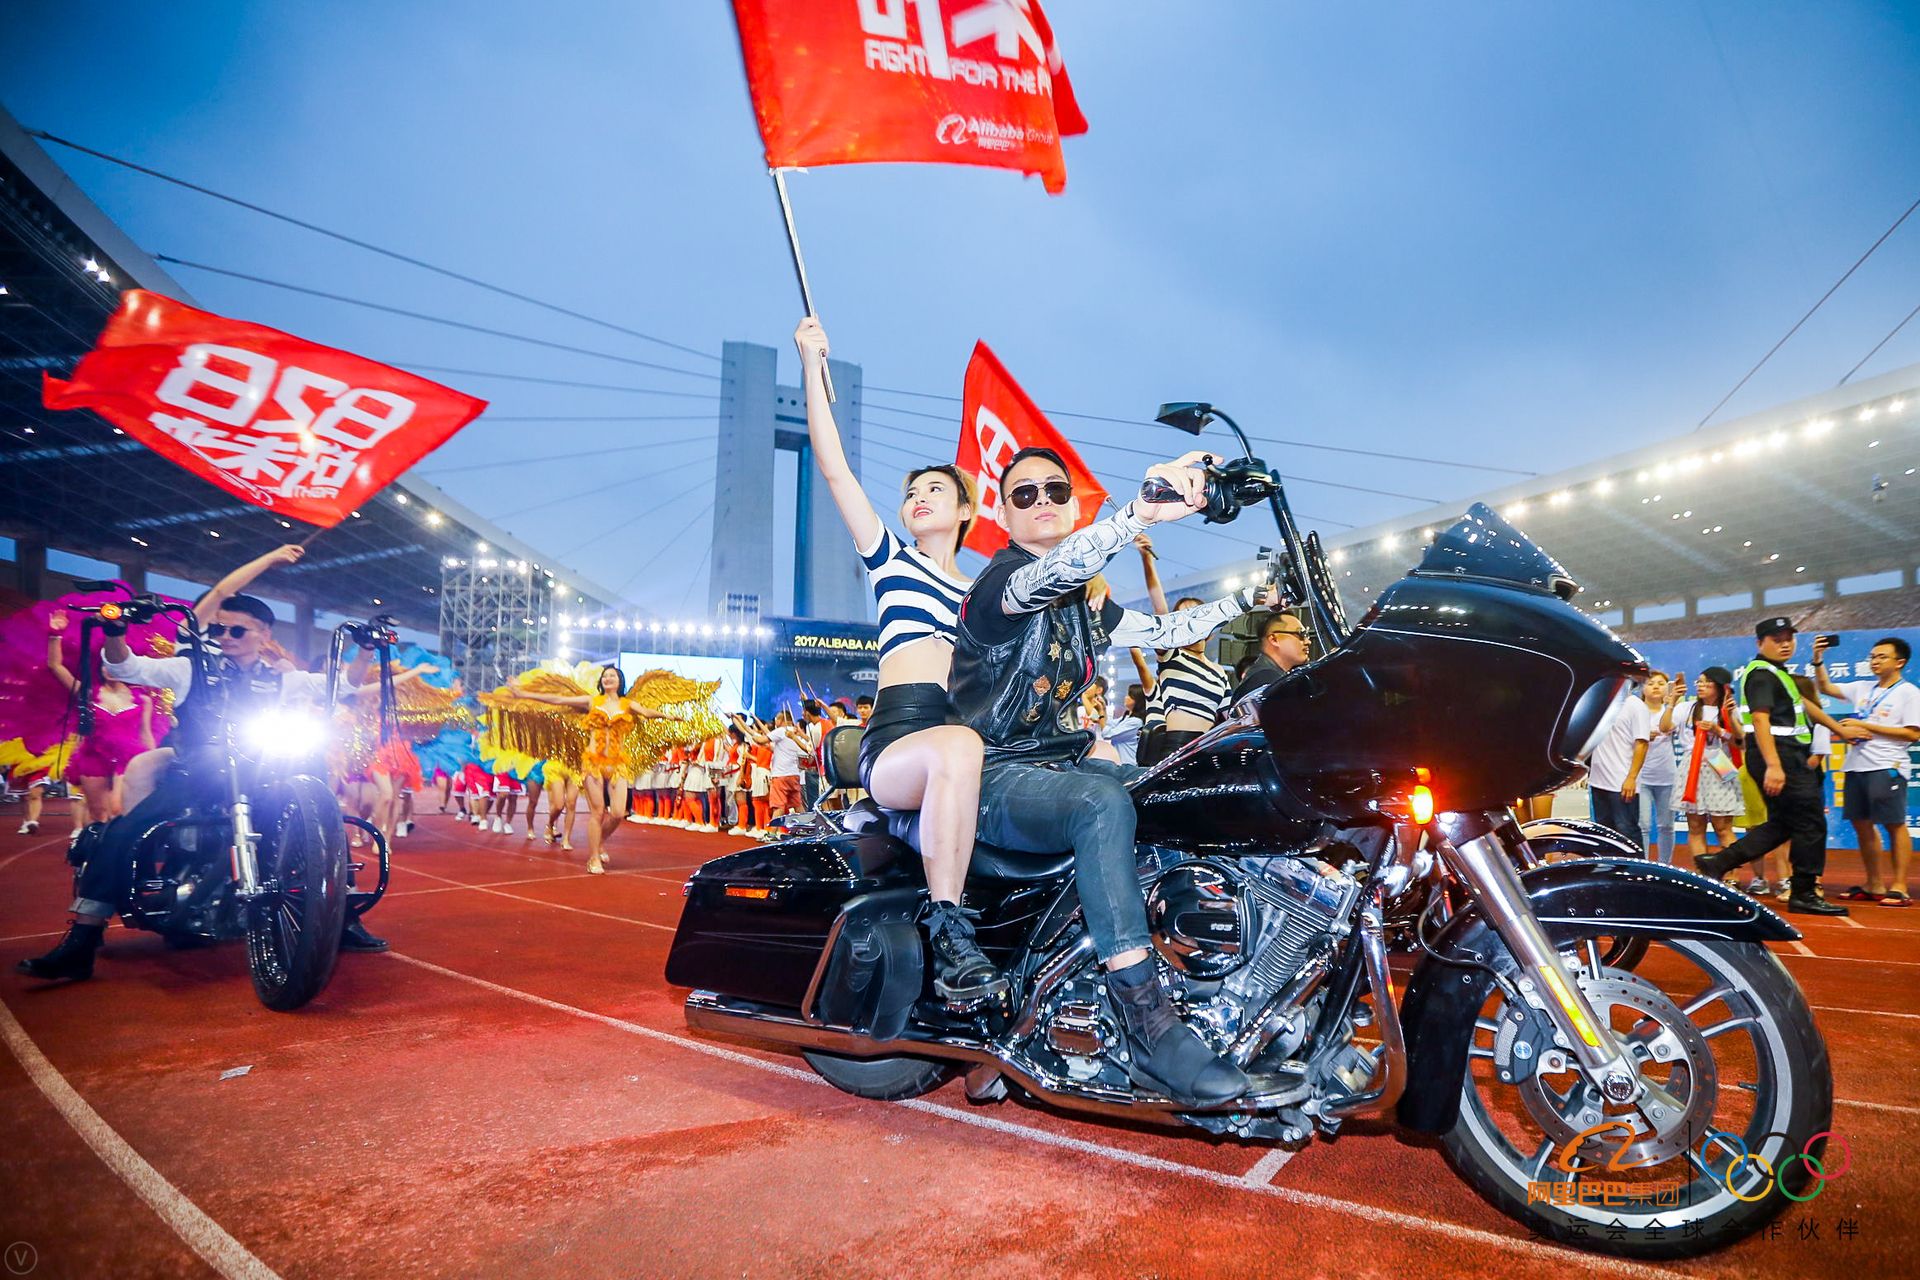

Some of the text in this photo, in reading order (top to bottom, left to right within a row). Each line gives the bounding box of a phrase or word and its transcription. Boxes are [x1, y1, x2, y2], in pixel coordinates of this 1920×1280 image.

[864, 38, 928, 77] FIGHT
[950, 56, 998, 89] FOR
[997, 63, 1038, 96] THE
[967, 115, 1025, 141] Alibaba
[794, 635, 817, 647] 2017
[818, 637, 863, 650] ALIBABA
